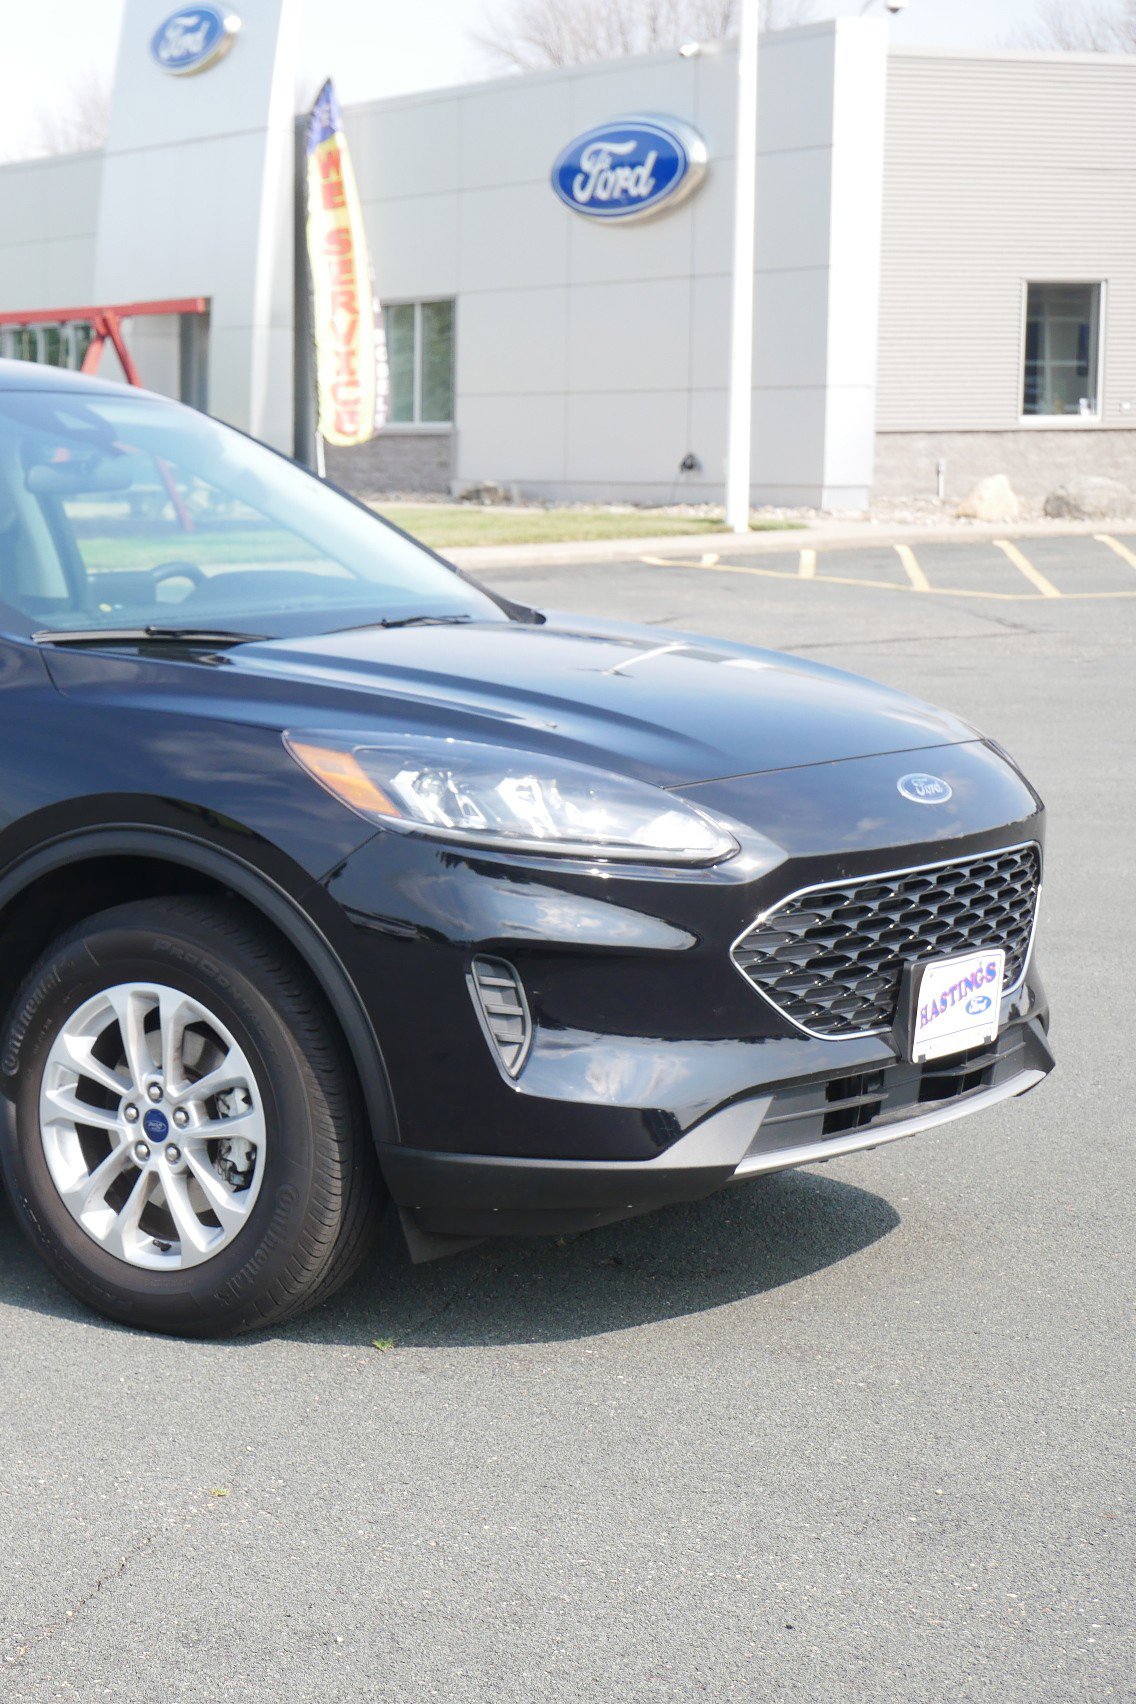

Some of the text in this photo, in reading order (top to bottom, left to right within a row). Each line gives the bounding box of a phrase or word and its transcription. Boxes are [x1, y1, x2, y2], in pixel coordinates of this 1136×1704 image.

[158, 15, 210, 59] Ford
[572, 140, 658, 204] Ford
[910, 778, 943, 797] Ford
